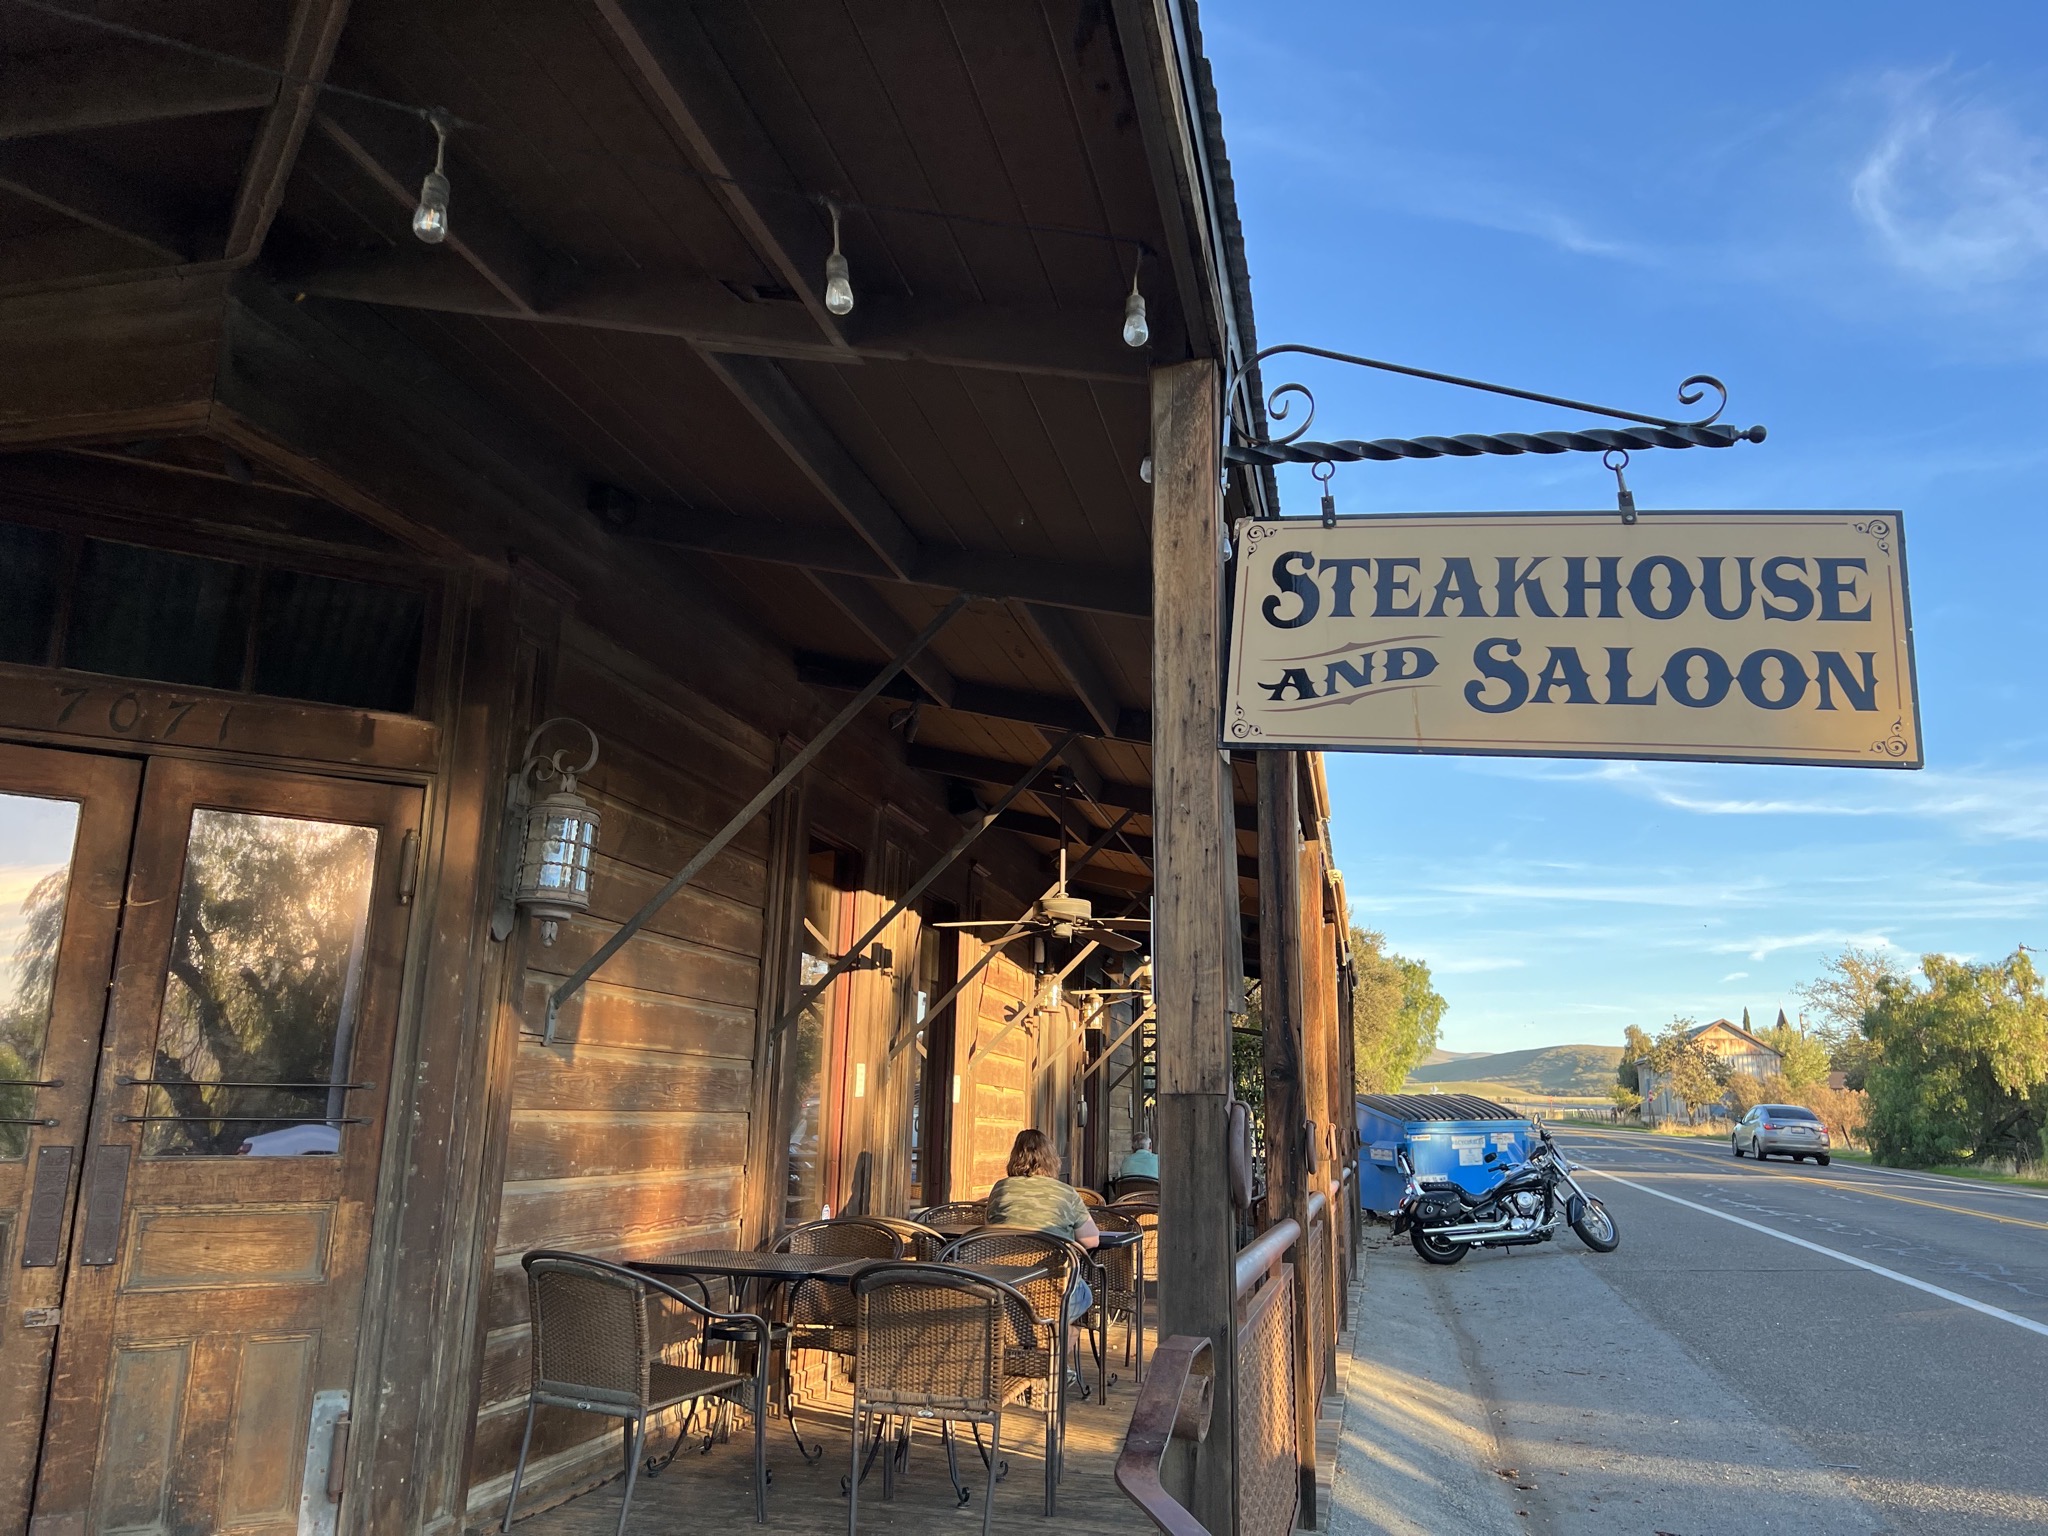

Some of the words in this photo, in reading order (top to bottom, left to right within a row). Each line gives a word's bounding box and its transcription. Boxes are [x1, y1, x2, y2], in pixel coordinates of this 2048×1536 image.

[1261, 550, 1872, 630] STEAKHOUSE
[1257, 646, 1440, 702] AND
[1463, 637, 1880, 713] SALOON
[57, 688, 233, 744] 7071
